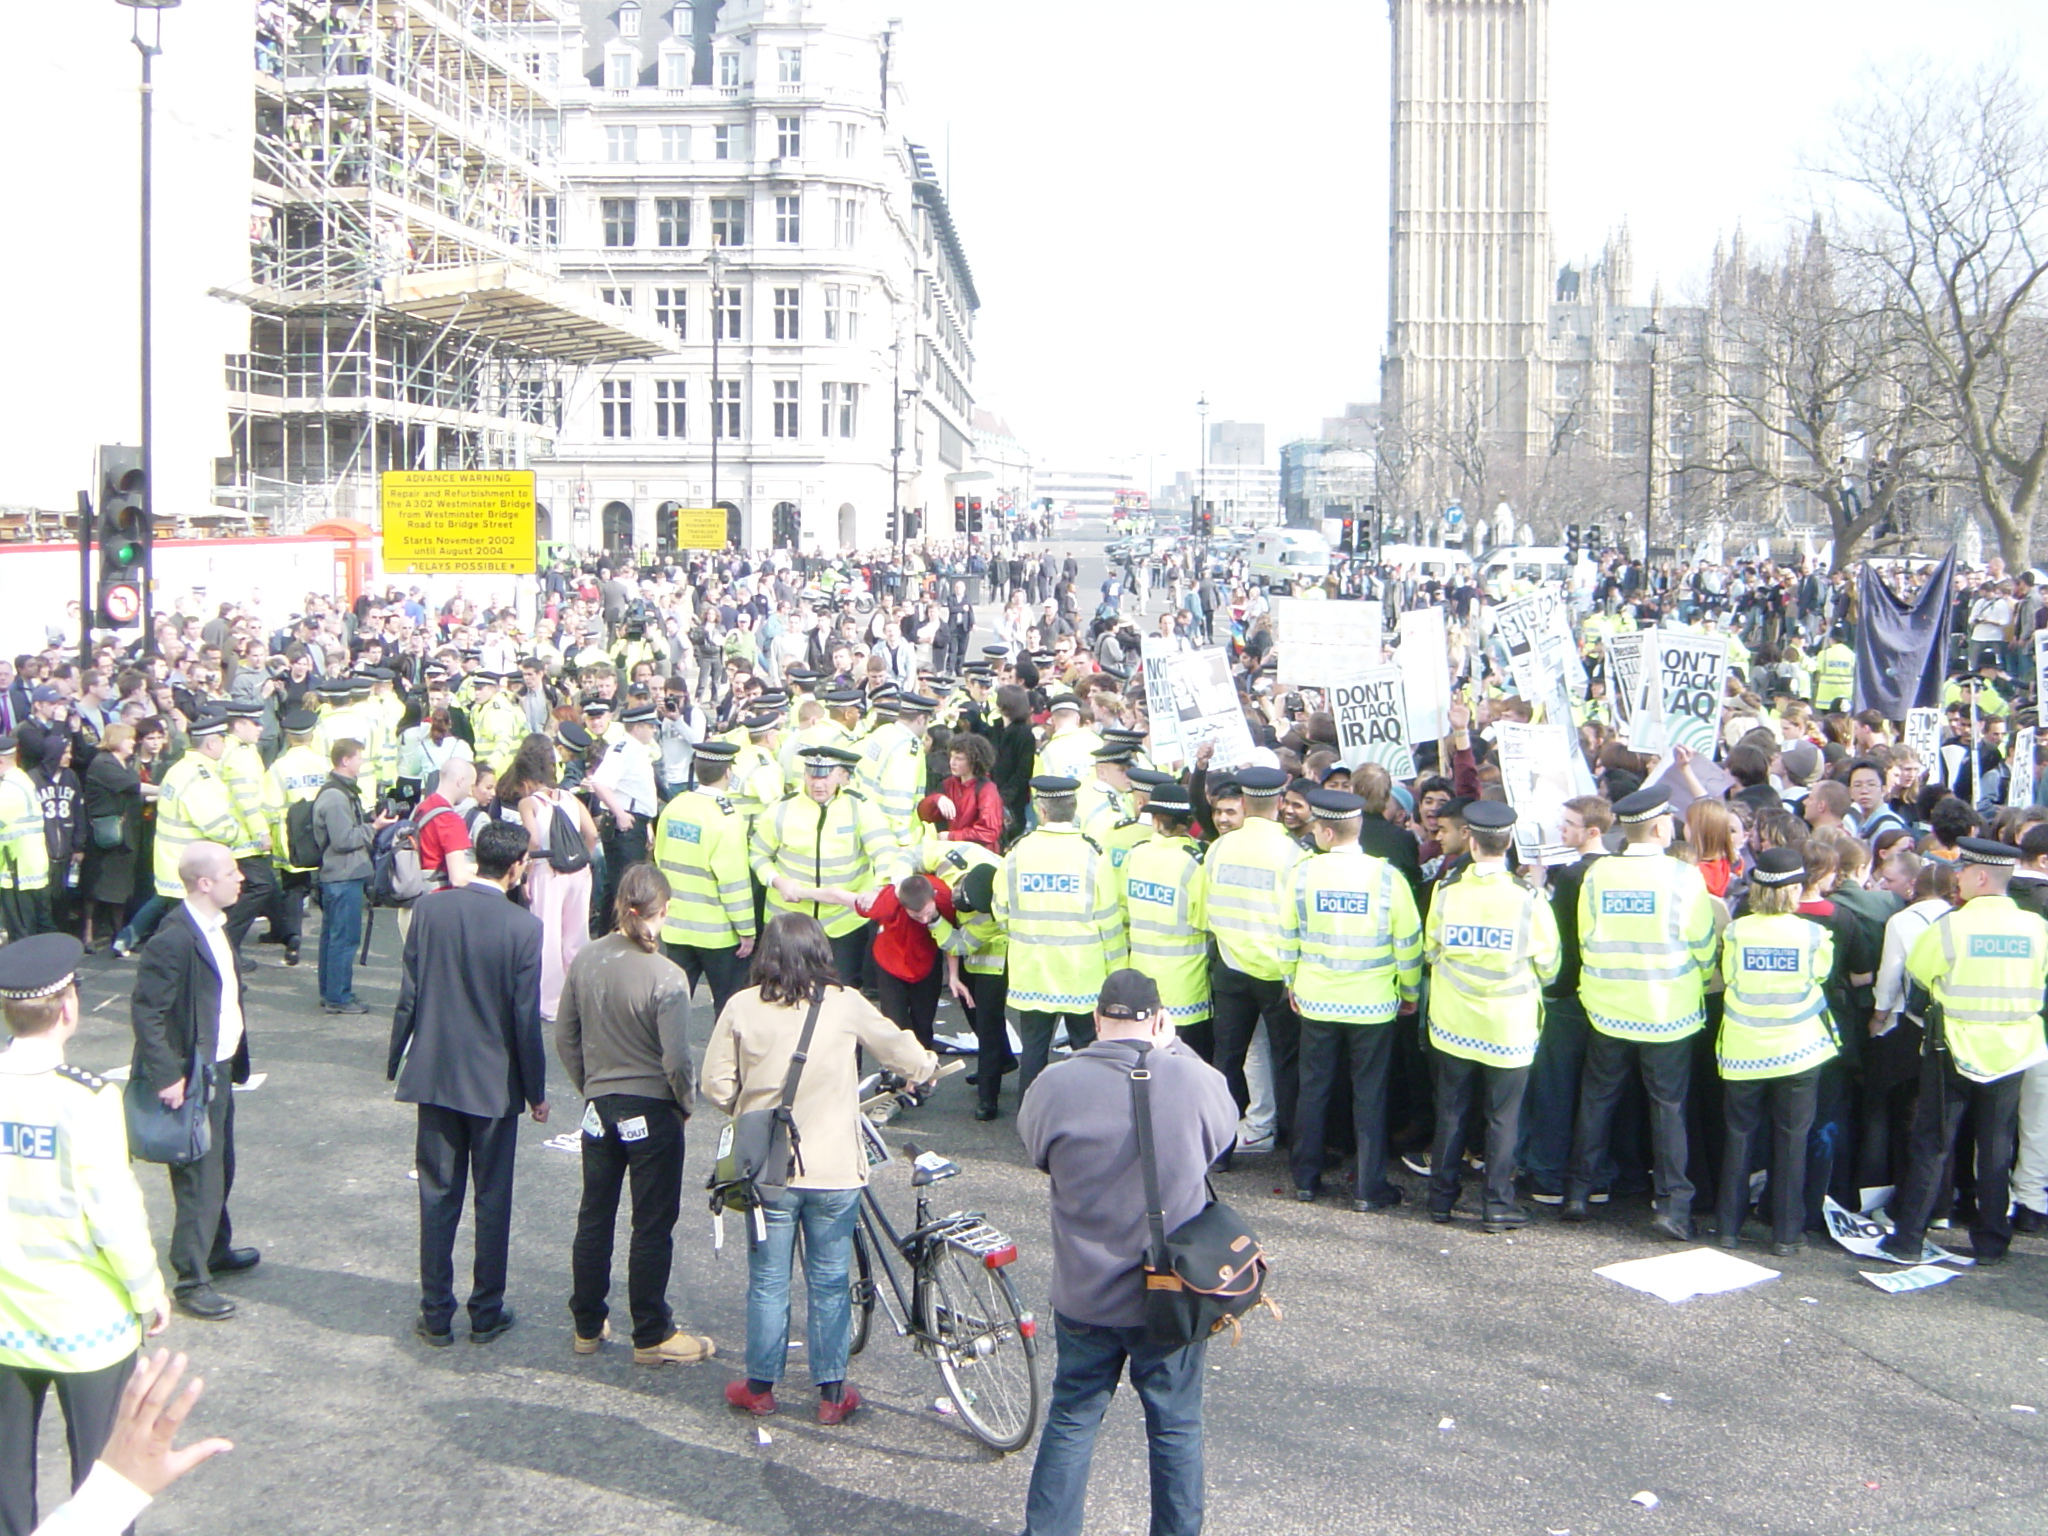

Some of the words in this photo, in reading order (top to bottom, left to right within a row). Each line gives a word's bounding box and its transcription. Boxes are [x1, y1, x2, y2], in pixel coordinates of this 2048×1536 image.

[406, 474, 455, 482] ADVANCE
[460, 474, 511, 482] WARNING
[390, 489, 420, 498] Repair
[424, 489, 441, 497] and
[444, 489, 515, 497] Refurbishment
[518, 489, 528, 497] to
[387, 500, 401, 508] the
[500, 501, 531, 509] Bridge
[487, 511, 519, 520] Bridge
[407, 520, 431, 528] Road
[448, 520, 479, 529] Bridge
[482, 520, 513, 528] Street
[403, 537, 433, 545] Starts
[436, 537, 484, 545] November
[488, 537, 515, 545] 2002
[439, 547, 472, 556] August
[476, 547, 503, 555] 2004
[455, 562, 507, 571] POSSIBLE
[1660, 649, 1721, 674] ON'T
[1662, 669, 1717, 691] TTACK
[1336, 681, 1394, 707] DON'T
[1341, 700, 1398, 722] ATTACK
[1909, 713, 1938, 731] STOP
[1341, 717, 1402, 747] IRAQ
[1908, 733, 1931, 751] THE
[1919, 752, 1937, 770] AR
[285, 775, 325, 789] POLICE
[45, 800, 71, 819] 38
[1021, 875, 1079, 892] POLICE
[1131, 882, 1173, 904] POLICE
[1320, 898, 1366, 912] POLICE
[1605, 899, 1652, 912] POLICE
[1446, 927, 1513, 949] POLICE
[1973, 938, 2028, 954] POLICE
[1747, 956, 1796, 970] POLICE
[626, 1128, 646, 1139] OUT
